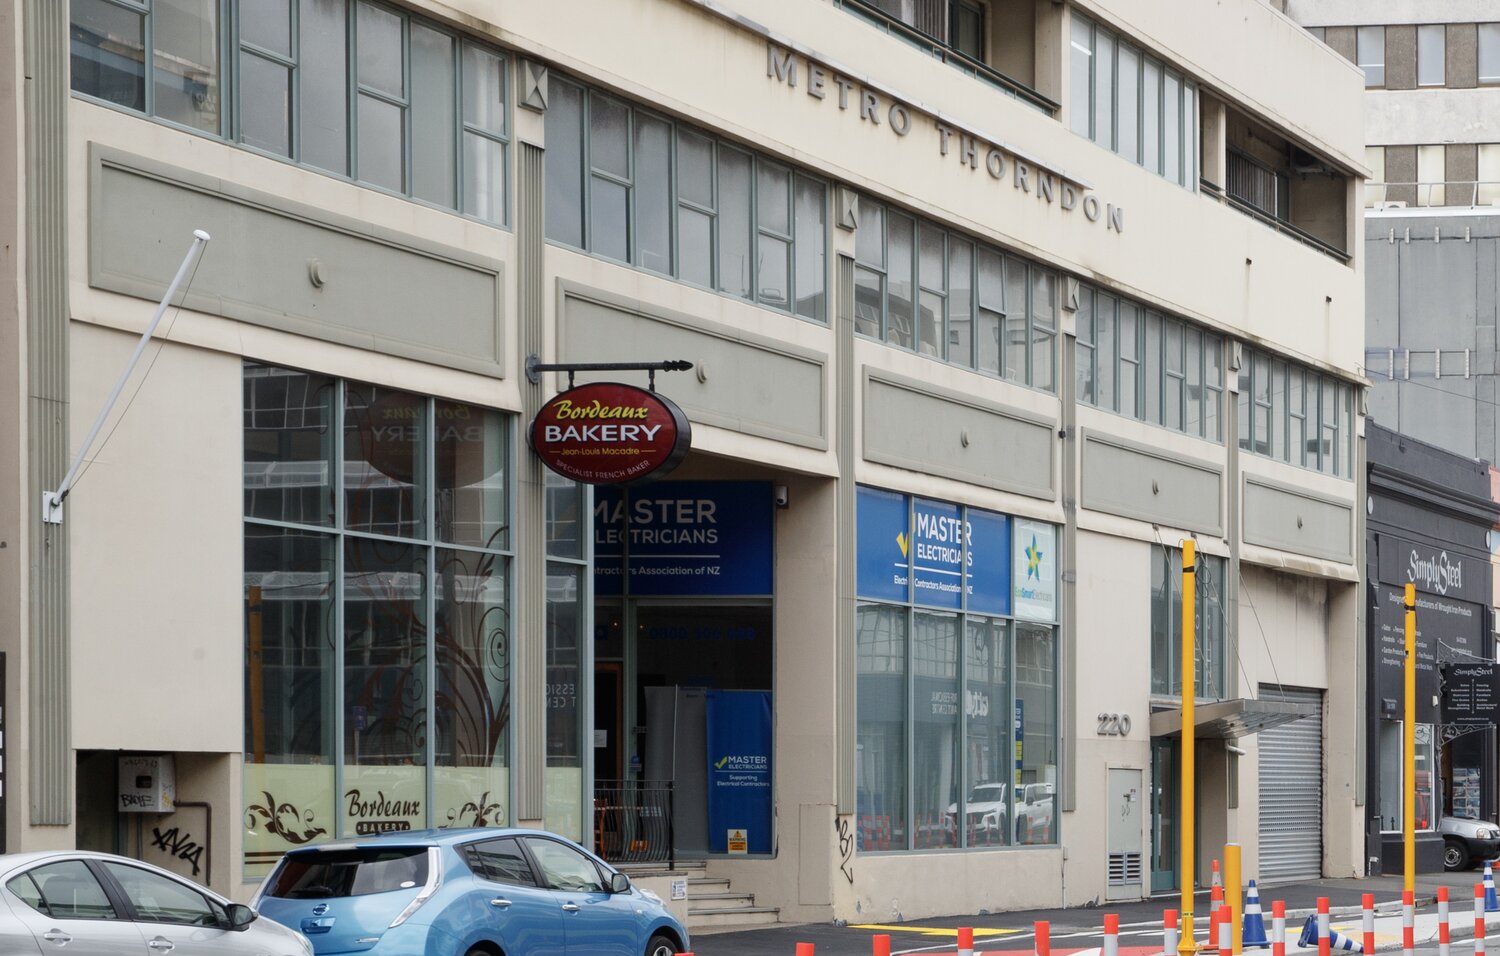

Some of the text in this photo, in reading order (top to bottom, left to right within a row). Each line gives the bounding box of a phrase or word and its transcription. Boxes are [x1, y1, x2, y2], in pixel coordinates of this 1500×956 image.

[767, 44, 1124, 233] METRO THORNDON
[553, 400, 648, 420] Bordeaux
[545, 424, 661, 442] BAKERY
[561, 448, 600, 456] Jean-Louis
[556, 459, 650, 479] SPECIALIST FRENCH BAKER
[595, 529, 719, 544] LECTRICIANS
[917, 543, 973, 567] ELECTRICIAS
[638, 566, 693, 575] Association
[695, 566, 705, 575] of
[707, 566, 720, 575] NZ
[914, 578, 939, 590] Contractors
[1097, 712, 1132, 737] 220
[728, 756, 767, 764] MASTER
[344, 789, 420, 818] Bordeaux
[362, 823, 403, 832] BAKERY
